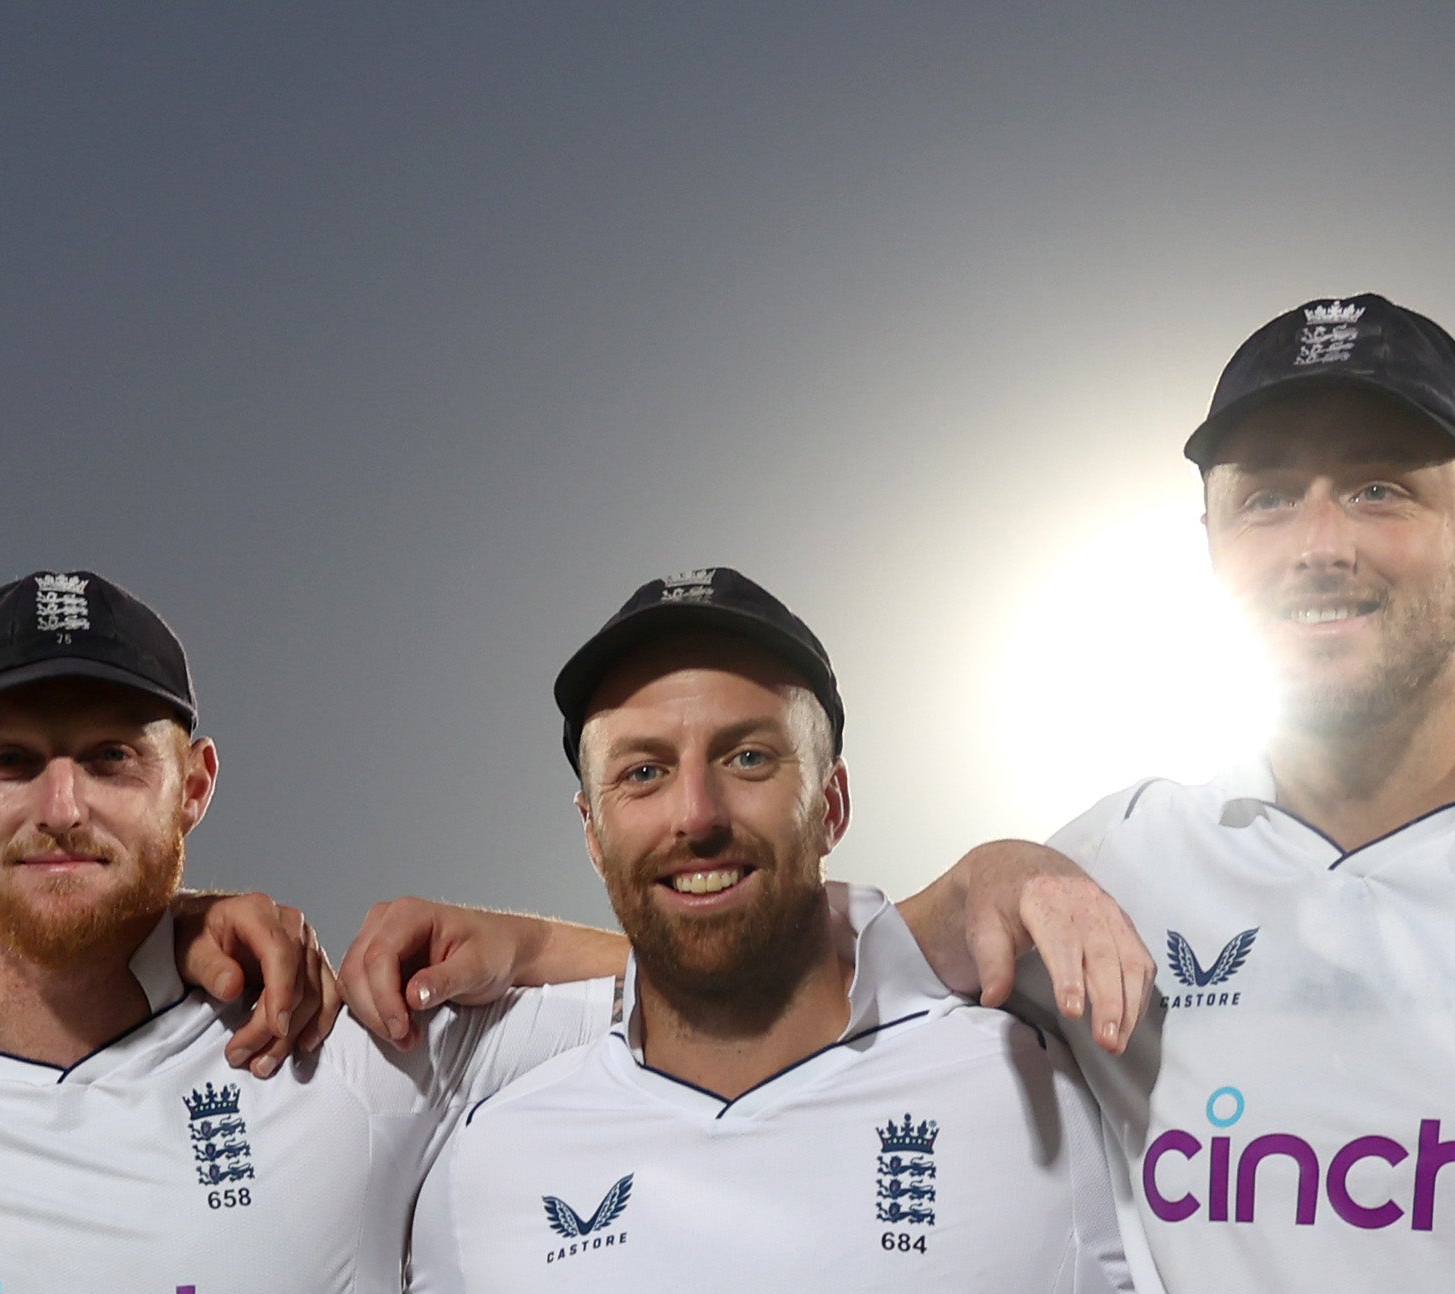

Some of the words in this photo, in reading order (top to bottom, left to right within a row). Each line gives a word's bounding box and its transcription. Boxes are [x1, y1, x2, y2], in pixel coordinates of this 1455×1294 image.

[1159, 992, 1241, 1009] CASTORE
[207, 1187, 252, 1210] 658
[546, 1231, 628, 1264] CASTORE
[881, 1231, 927, 1254] 684
